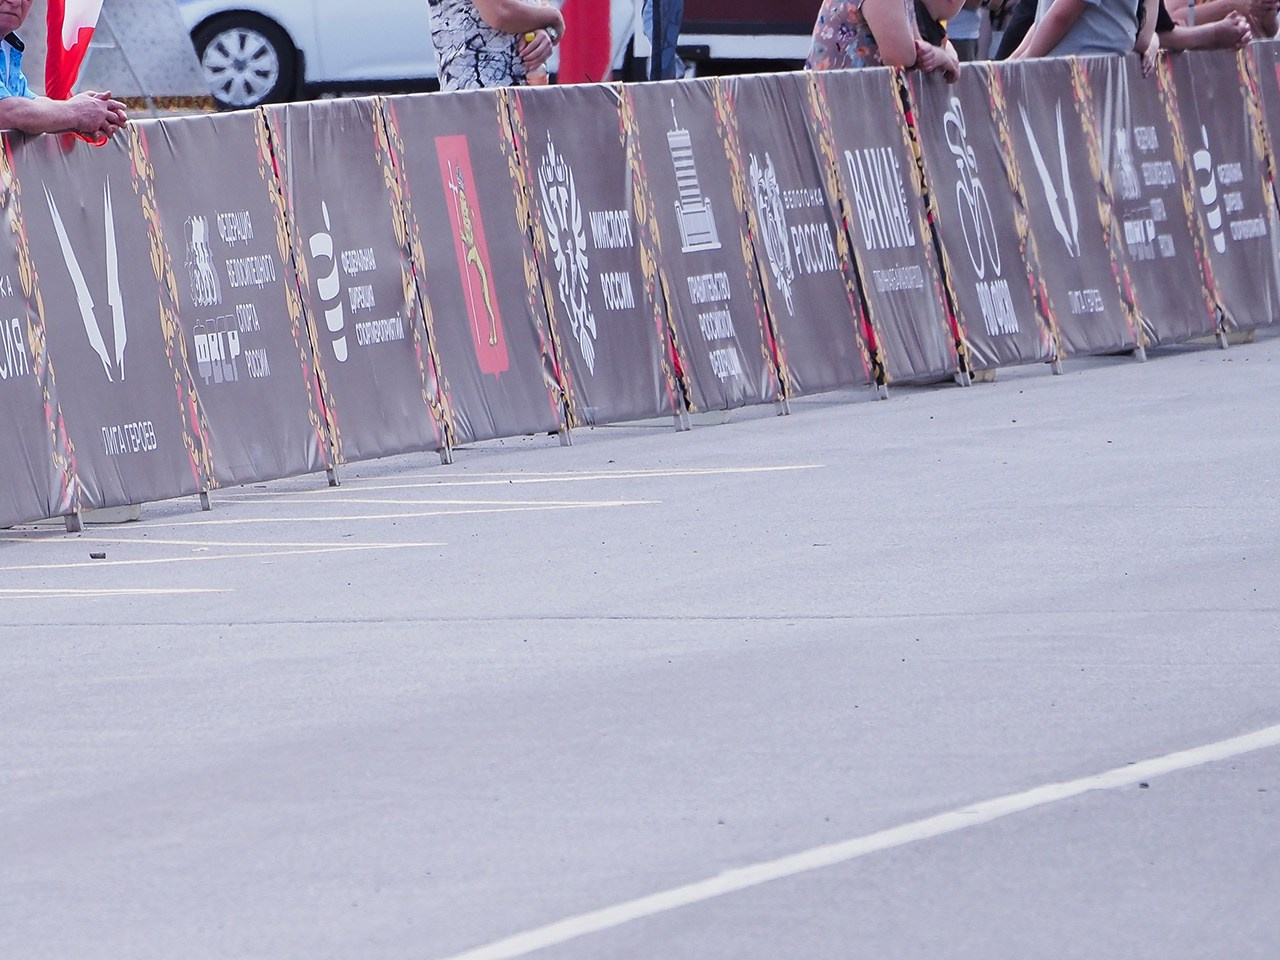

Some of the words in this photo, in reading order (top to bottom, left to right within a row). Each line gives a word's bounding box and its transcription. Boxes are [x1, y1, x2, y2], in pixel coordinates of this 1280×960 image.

[589, 210, 634, 249] МИНСПОРТ
[790, 223, 838, 275] РОССИЯ
[600, 272, 635, 311] РОССИИ
[101, 424, 127, 456] ЛИГА
[124, 421, 157, 453] ГЕРОЕВ
